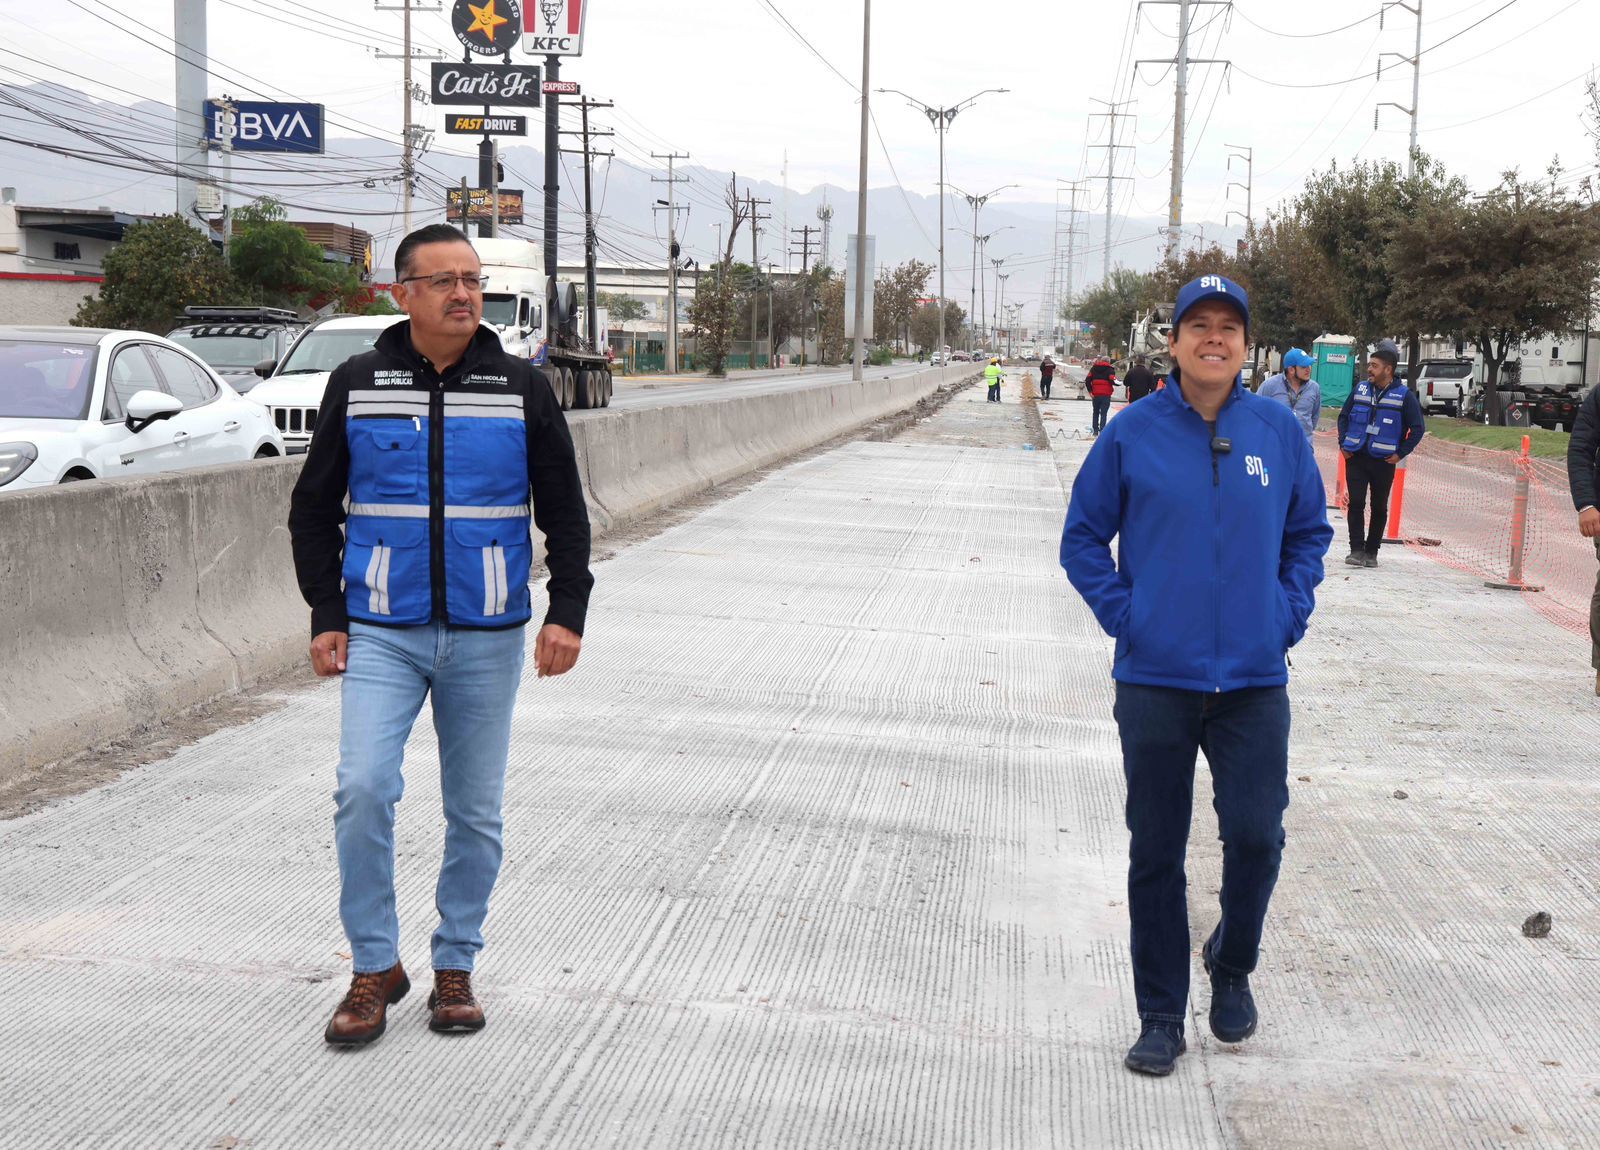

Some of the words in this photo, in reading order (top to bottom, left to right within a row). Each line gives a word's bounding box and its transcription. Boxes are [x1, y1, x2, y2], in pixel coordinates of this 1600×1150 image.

[458, 32, 497, 53] BURGERS
[531, 37, 571, 51] KFC
[438, 70, 499, 96] Carl's
[500, 71, 532, 98] Jr.
[542, 82, 576, 92] EXPRESS
[455, 117, 484, 130] FAST
[483, 119, 517, 131] DRIVE
[374, 378, 391, 386] OBRAS
[391, 377, 413, 385] PÚBLICAS
